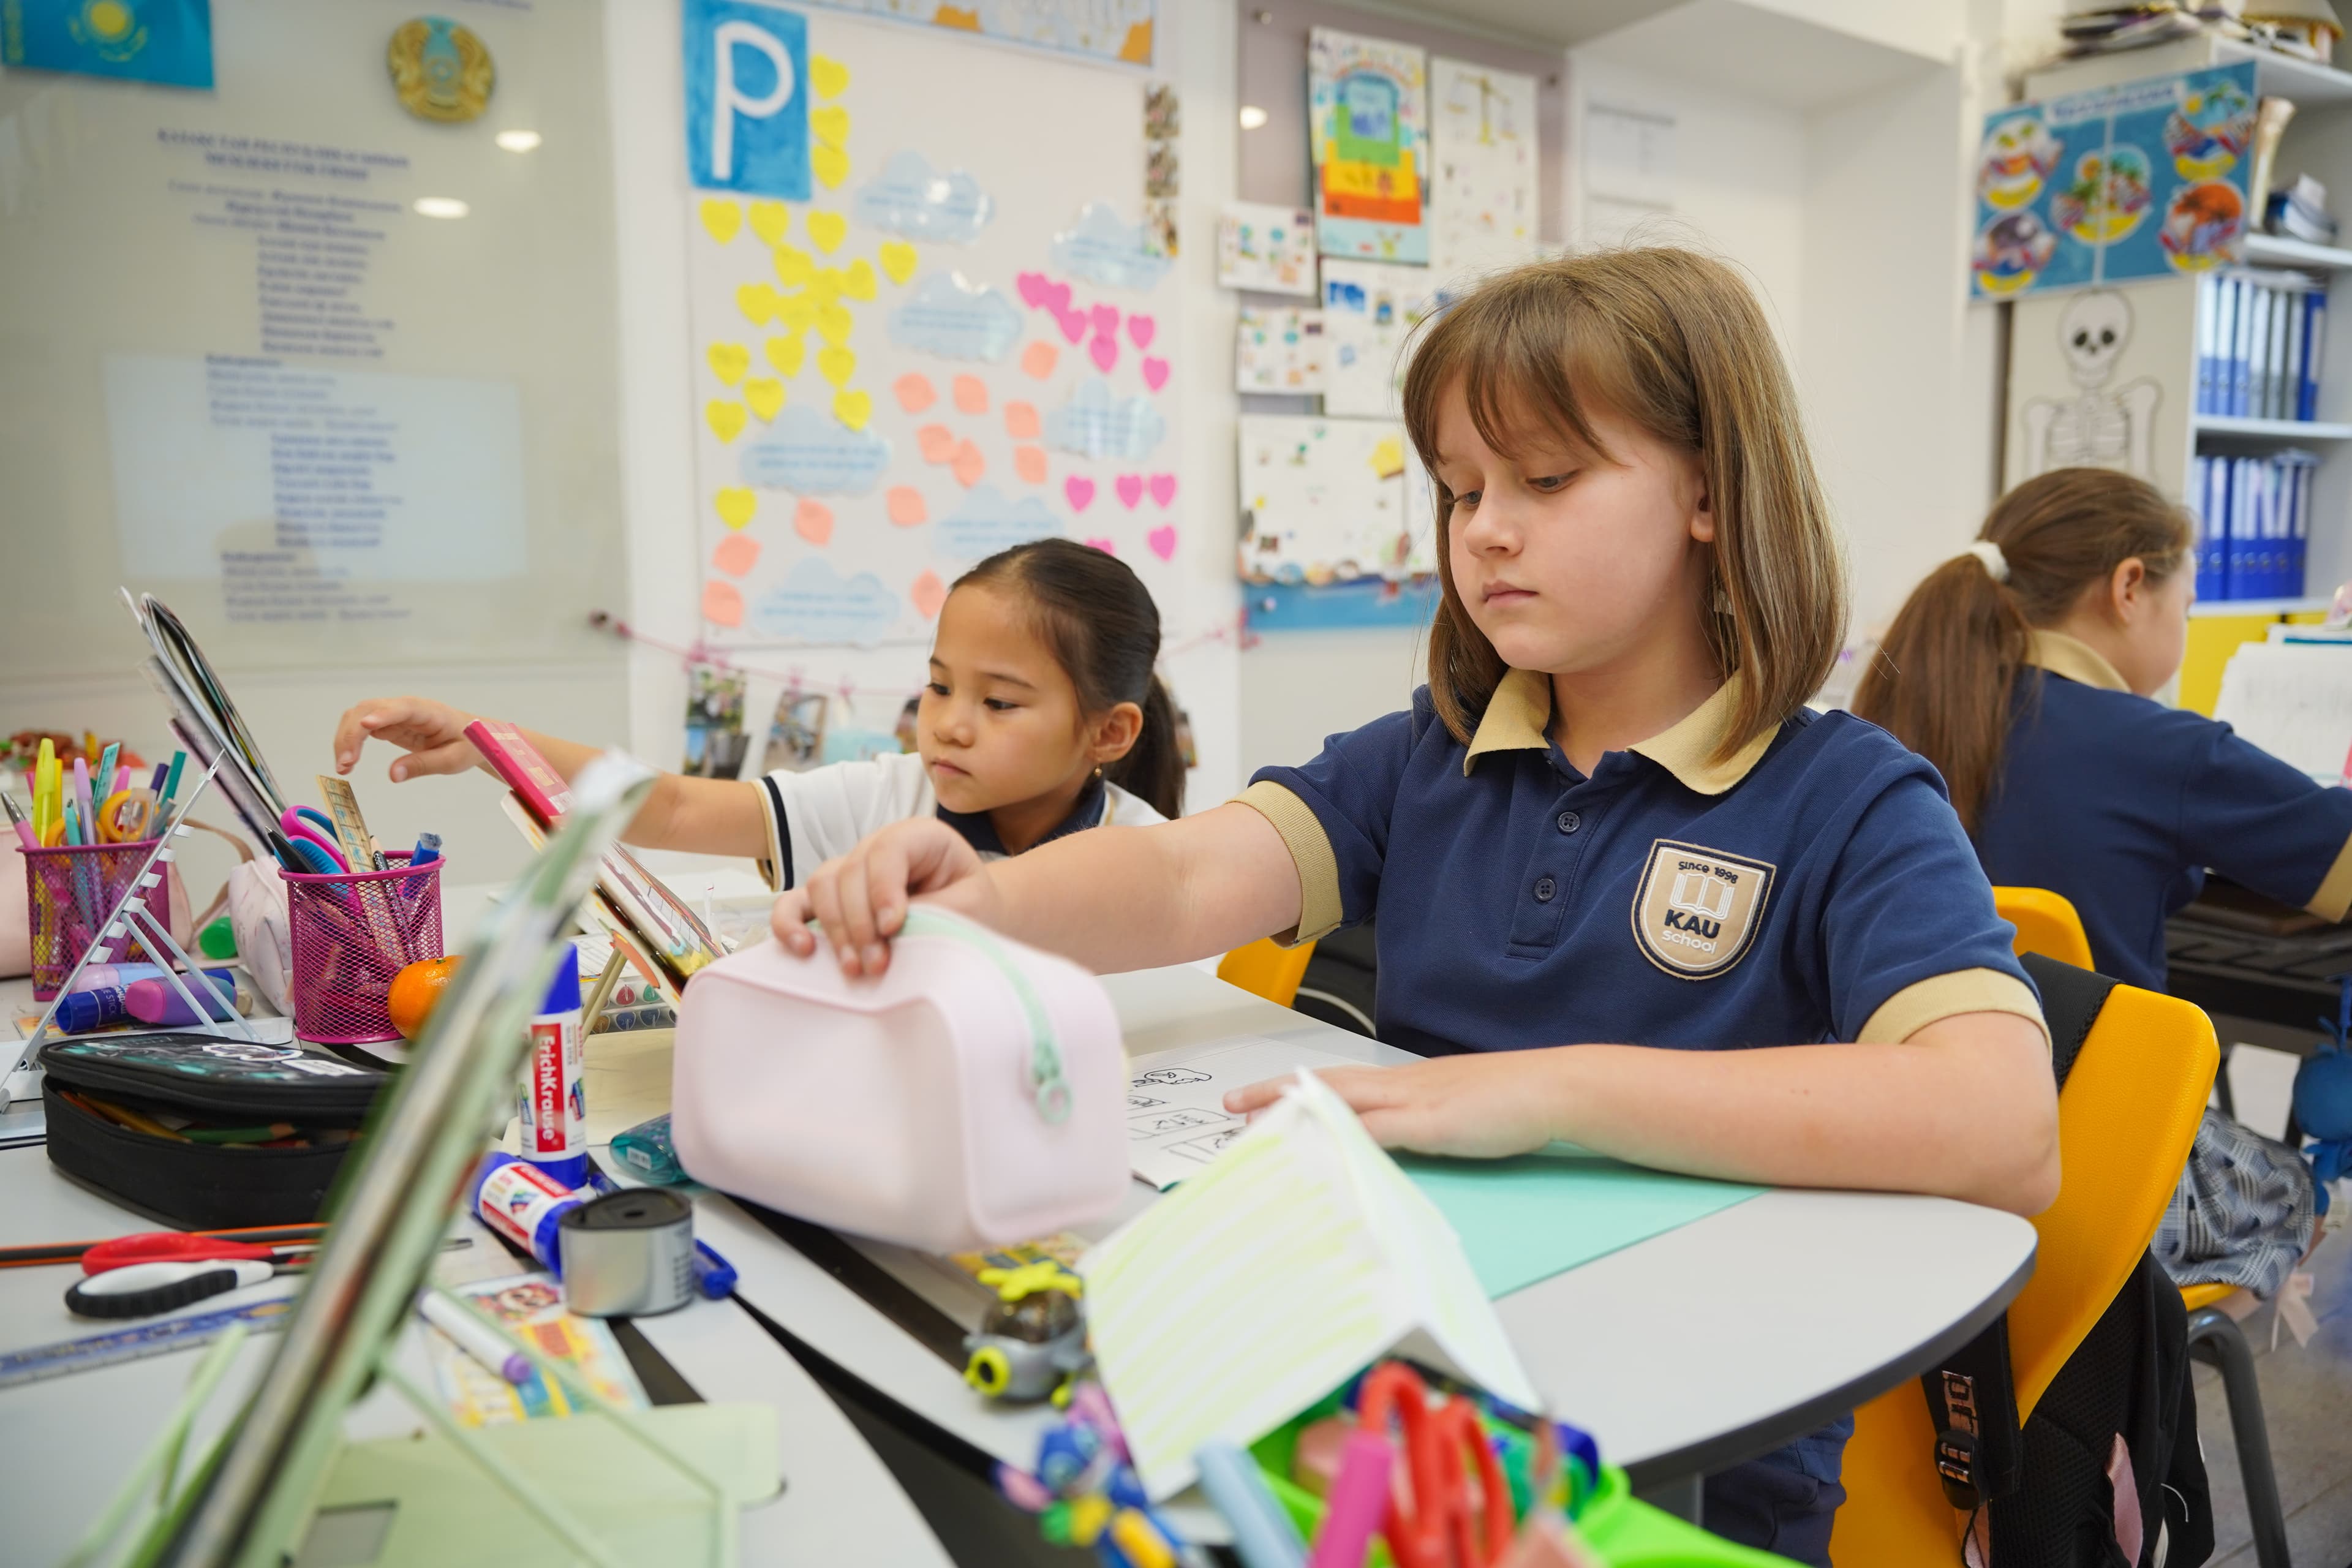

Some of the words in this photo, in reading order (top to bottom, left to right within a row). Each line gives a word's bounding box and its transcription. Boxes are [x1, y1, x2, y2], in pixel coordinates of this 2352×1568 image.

[712, 19, 794, 180] P
[1678, 861, 1709, 873] since
[1714, 867, 1738, 884] 1998
[1664, 909, 1721, 938] KAU
[1662, 930, 1717, 954] school
[538, 1035, 558, 1140] ErichKrause
